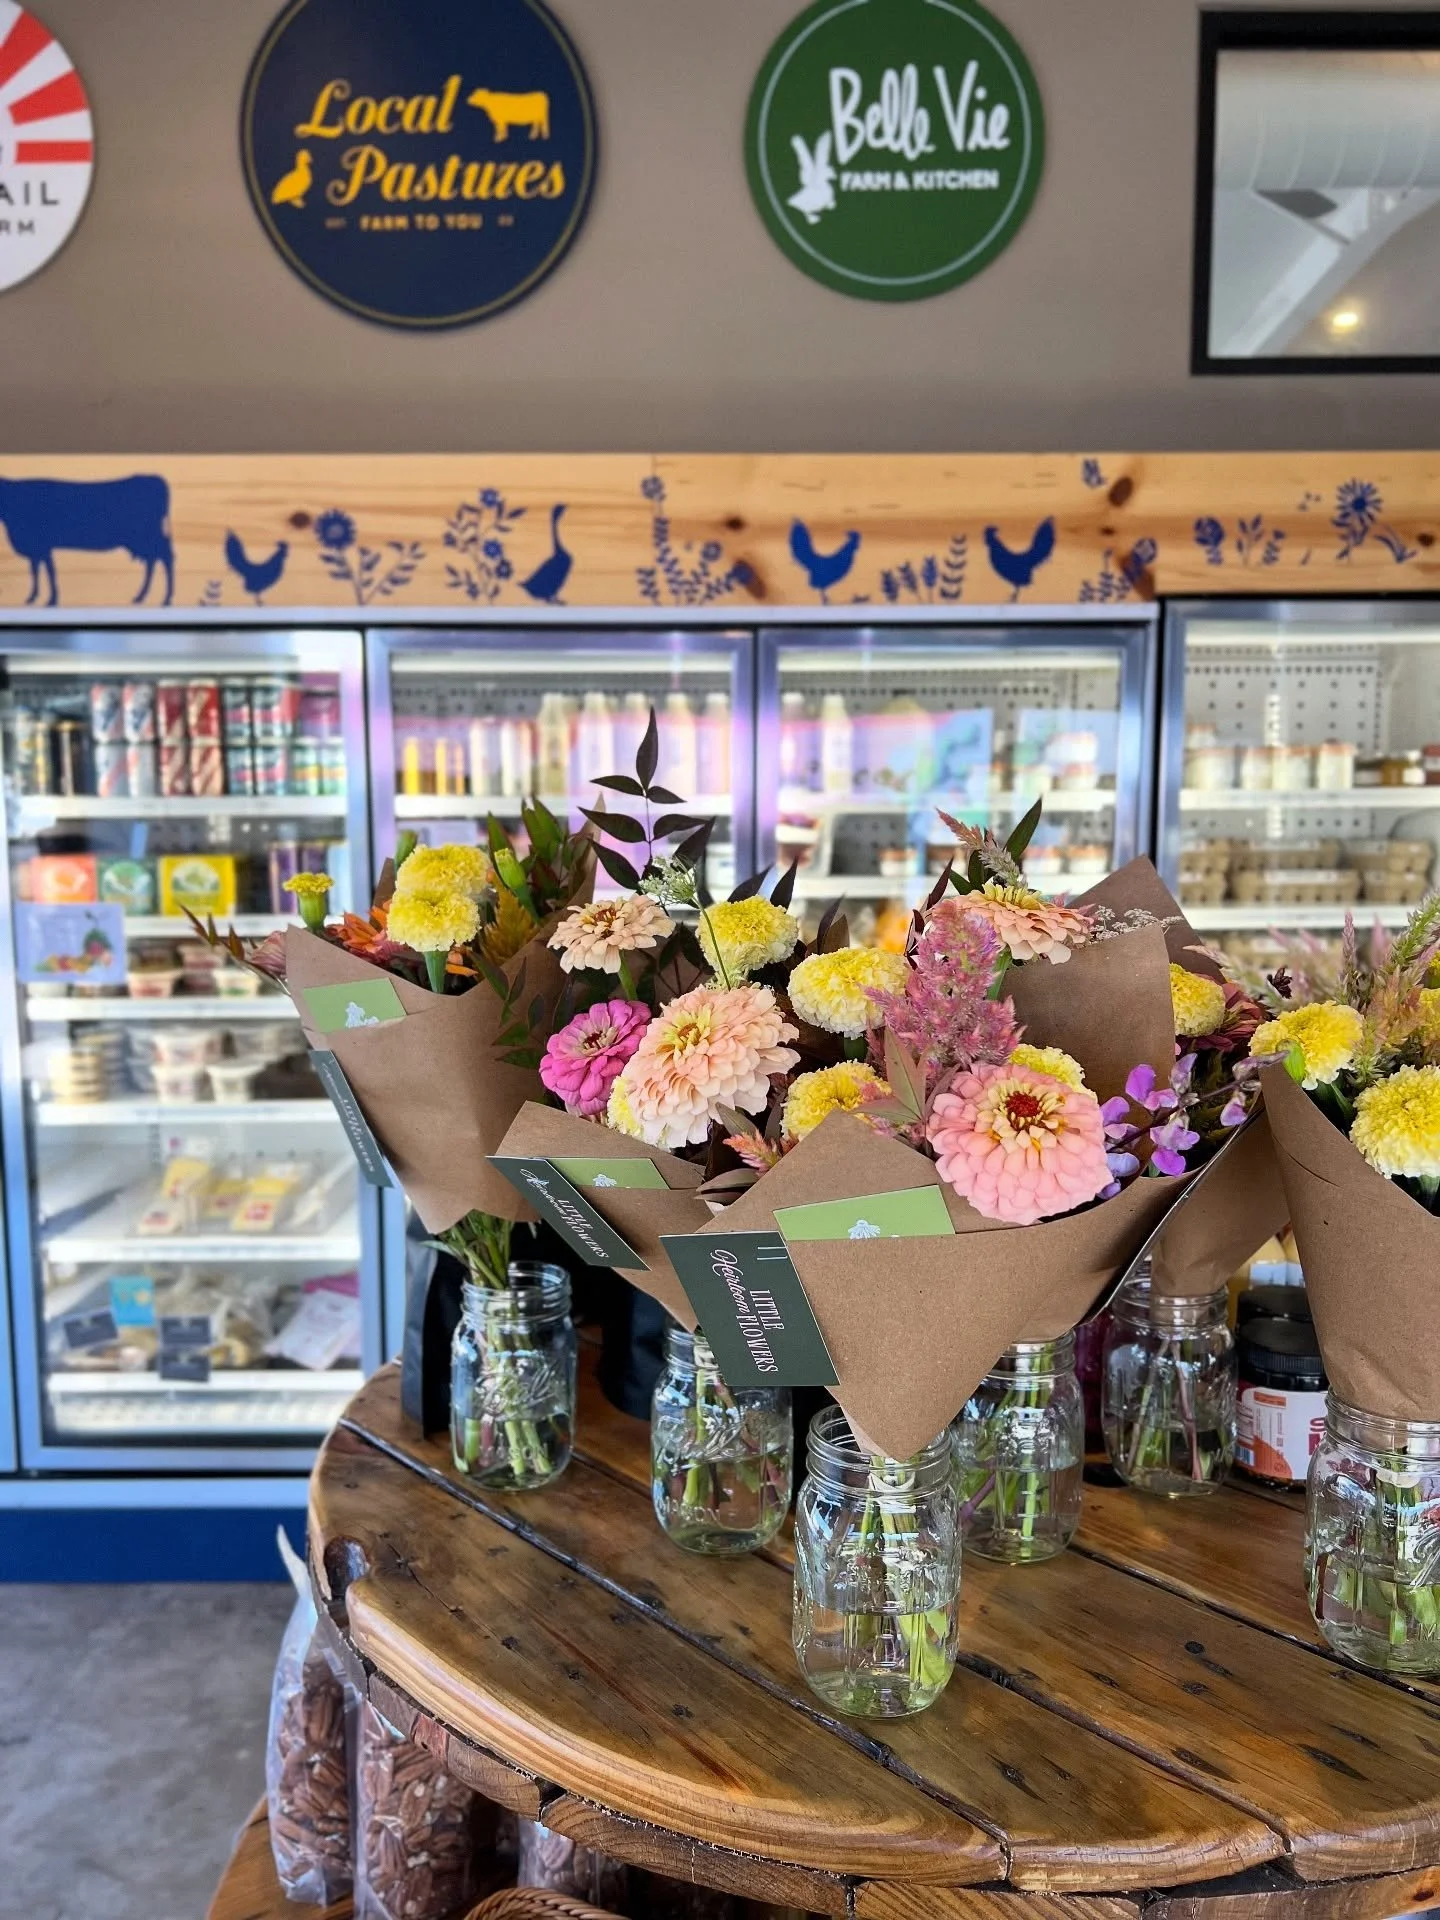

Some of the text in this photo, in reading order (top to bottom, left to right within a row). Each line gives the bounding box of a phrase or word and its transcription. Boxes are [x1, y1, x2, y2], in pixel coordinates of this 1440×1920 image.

[294, 74, 462, 138] Local
[830, 60, 1010, 165] Belle Vie
[326, 144, 565, 206] Pastures
[840, 171, 891, 191] FARM
[912, 169, 999, 190] KITCHEN
[360, 214, 410, 231] FARM
[414, 213, 440, 231] TO
[445, 213, 483, 231] YOU
[557, 1199, 594, 1230] LITTLE
[561, 1215, 610, 1258] FLOWERS
[709, 1248, 779, 1373] Heirloom FLOWERS
[749, 1289, 785, 1330] LITTLE
